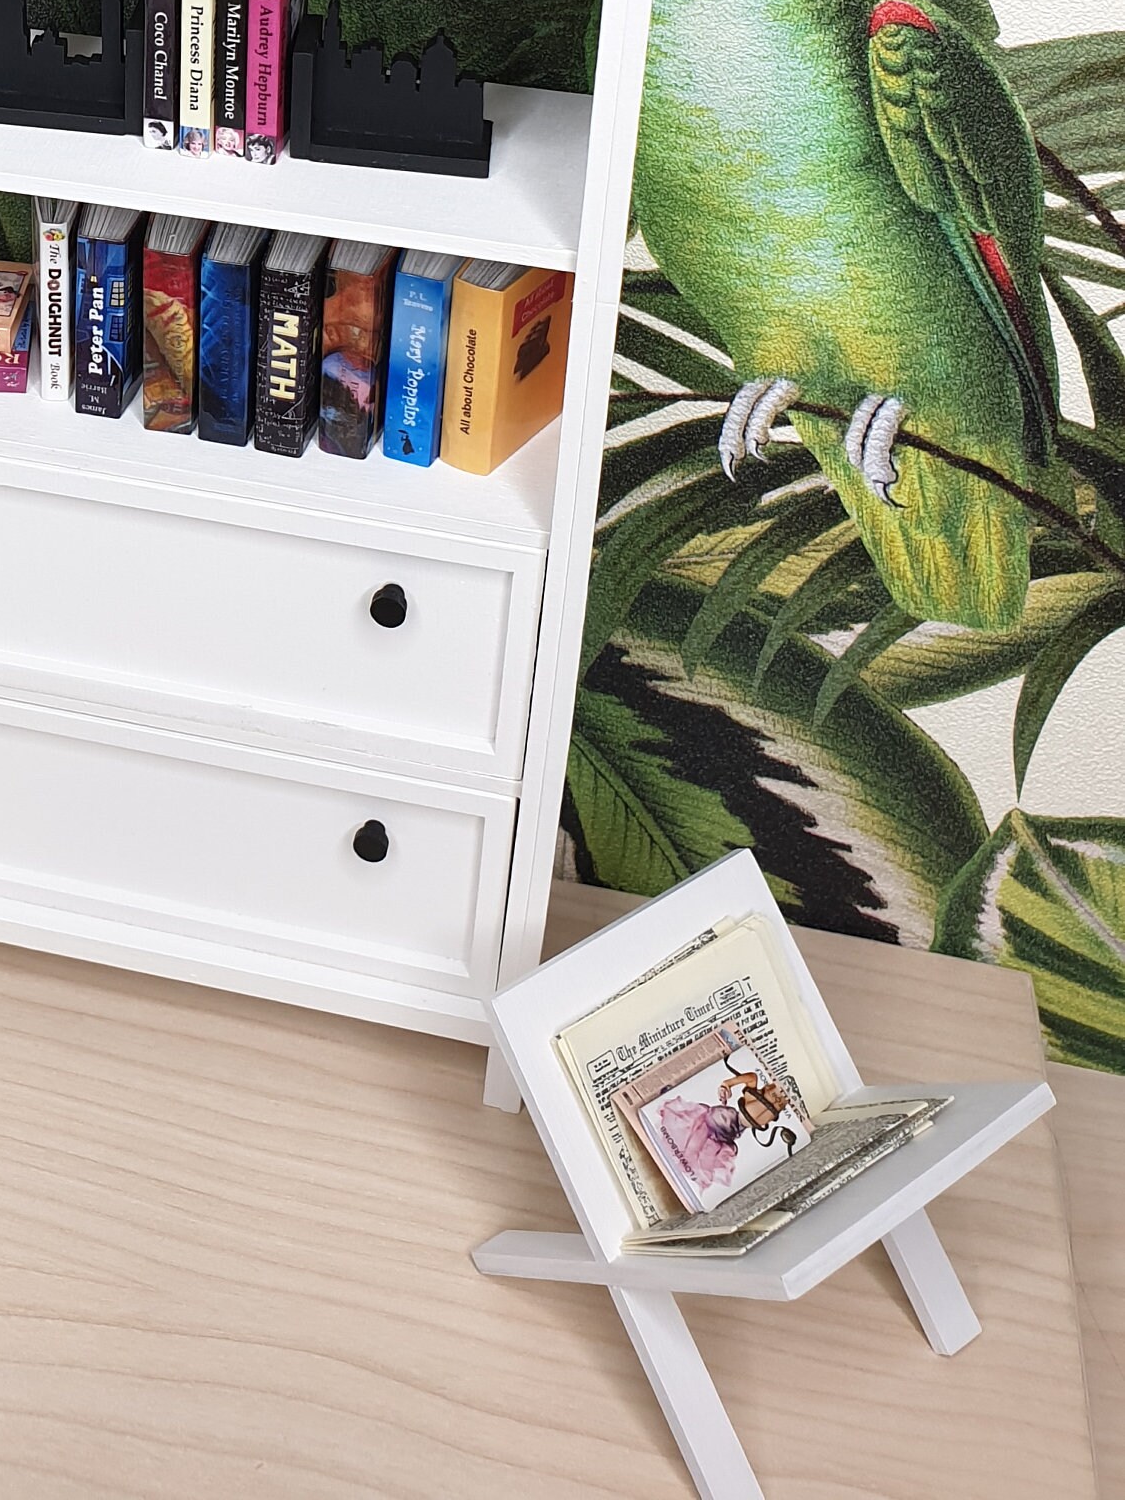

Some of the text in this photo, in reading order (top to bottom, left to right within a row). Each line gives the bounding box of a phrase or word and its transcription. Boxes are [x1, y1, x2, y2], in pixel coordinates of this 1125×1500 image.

[154, 11, 169, 101] Coco Chanel
[189, 5, 204, 112] Princess Diana
[222, 2, 242, 120] Marilyn Monroe
[253, 5, 274, 127] Audrey Hepburn
[47, 243, 62, 390] The DOUGHNUT Book
[87, 286, 105, 376] Peter Pan
[269, 311, 299, 400] MATH
[81, 382, 107, 394] Barrie
[81, 403, 106, 415] James
[403, 324, 426, 427] Mary Poppins
[460, 328, 477, 435] All about Chocolate
[615, 1044, 637, 1062] The
[638, 1018, 685, 1055] Miniature
[660, 1126, 698, 1182] FLOWERBOMB
